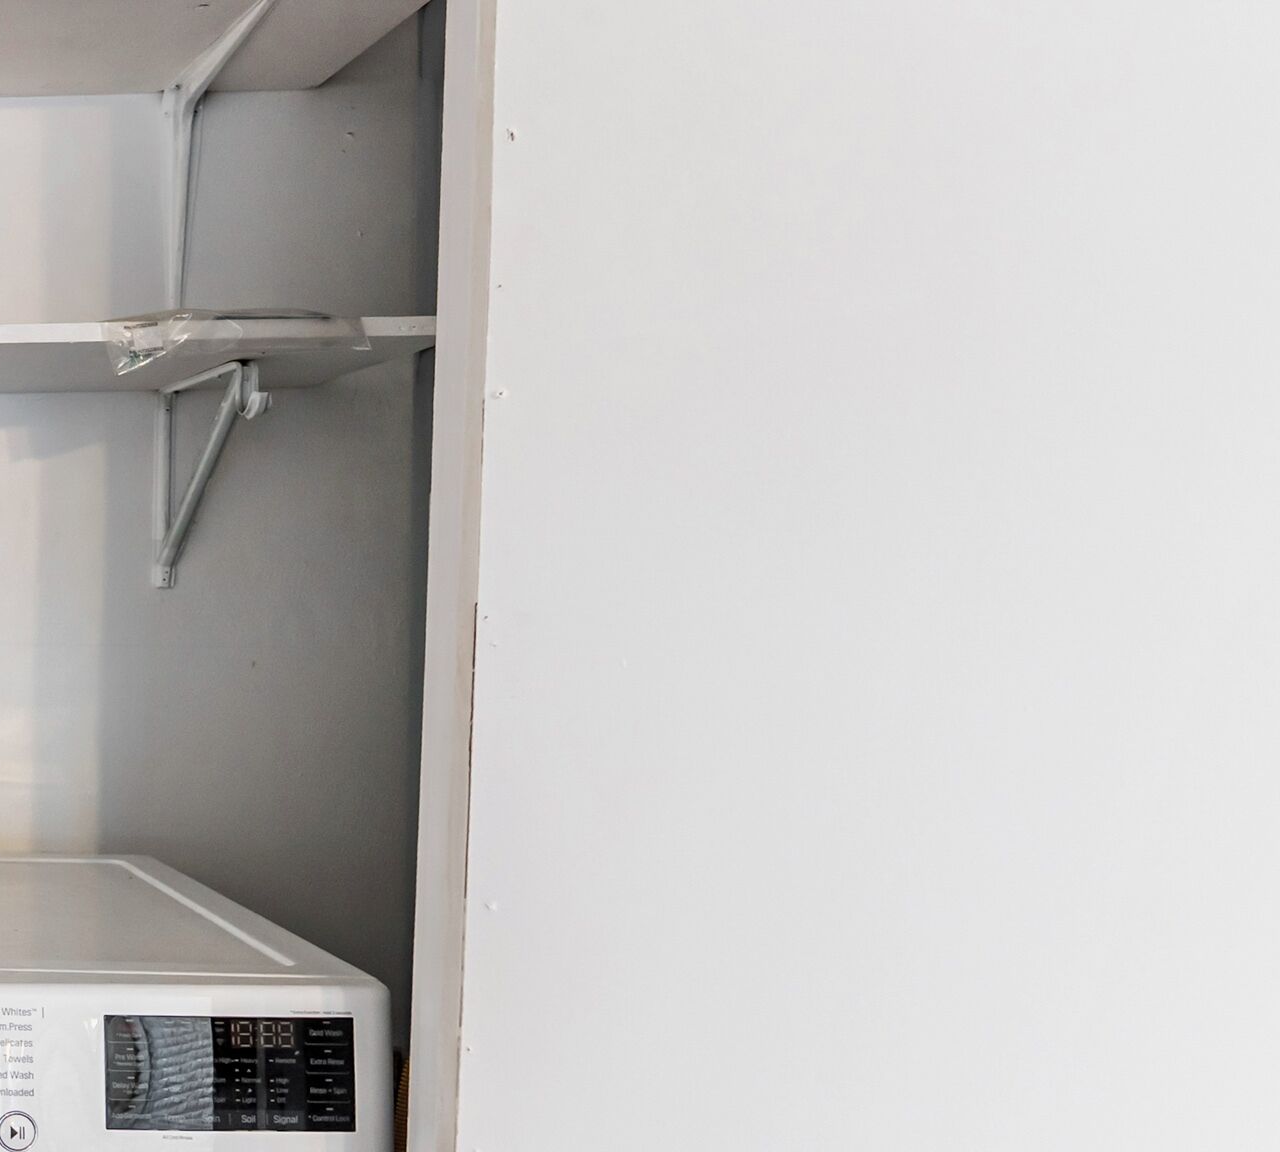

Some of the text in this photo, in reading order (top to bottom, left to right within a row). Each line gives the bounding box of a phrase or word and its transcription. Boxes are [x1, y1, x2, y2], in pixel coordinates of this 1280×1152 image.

[3, 1054, 34, 1063] Towels
[10, 1071, 34, 1079] Wash
[241, 1115, 256, 1123] Soil
[273, 1115, 298, 1124] Signal
